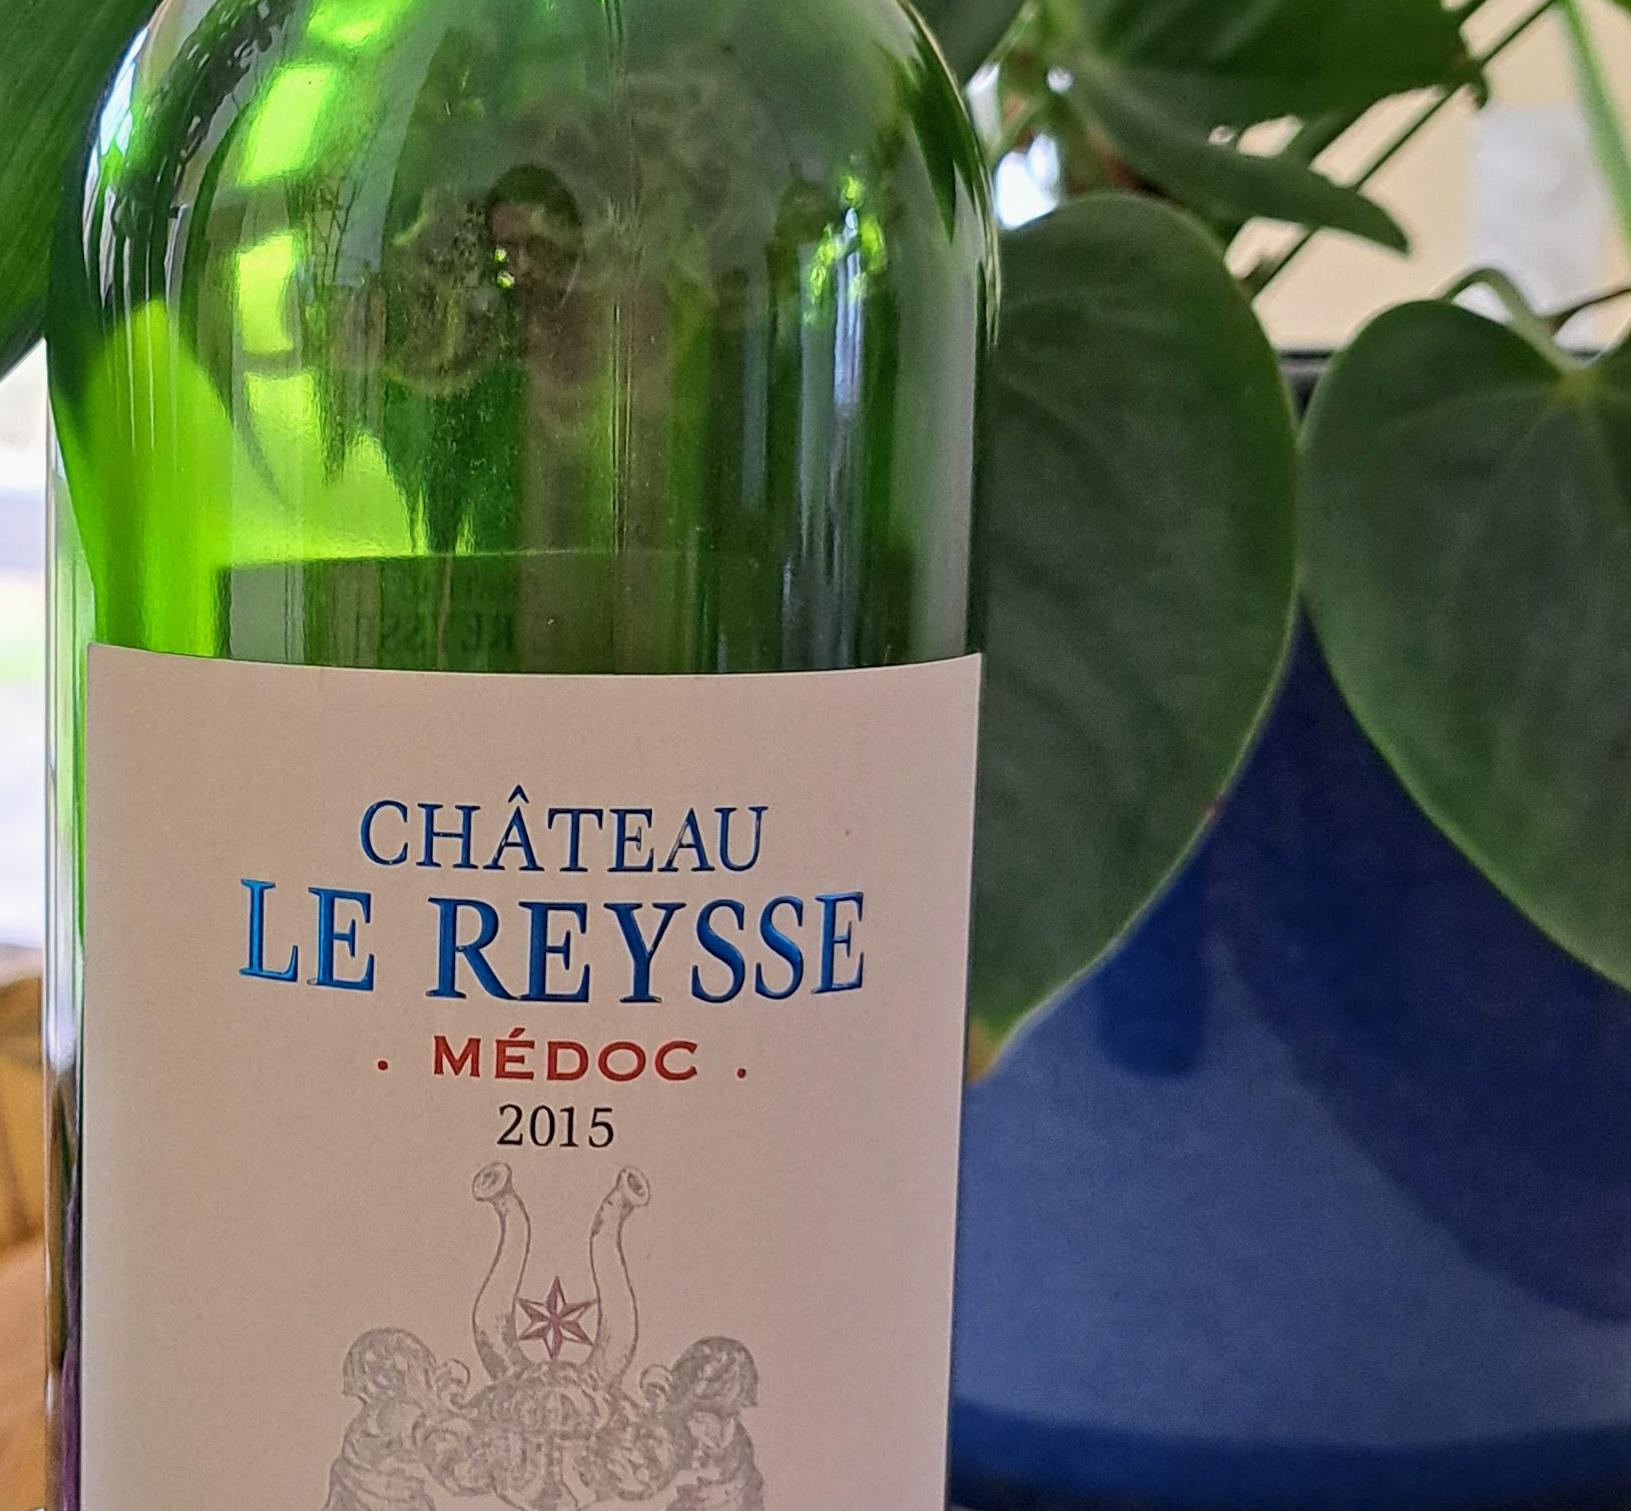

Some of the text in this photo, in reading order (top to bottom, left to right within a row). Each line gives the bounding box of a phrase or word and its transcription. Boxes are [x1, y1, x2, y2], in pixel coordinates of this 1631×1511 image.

[359, 784, 770, 873] CHÂTEAU
[238, 877, 866, 1004] LE REYSSE
[432, 1027, 699, 1083] MÉDOC
[496, 1103, 616, 1150] 2015
